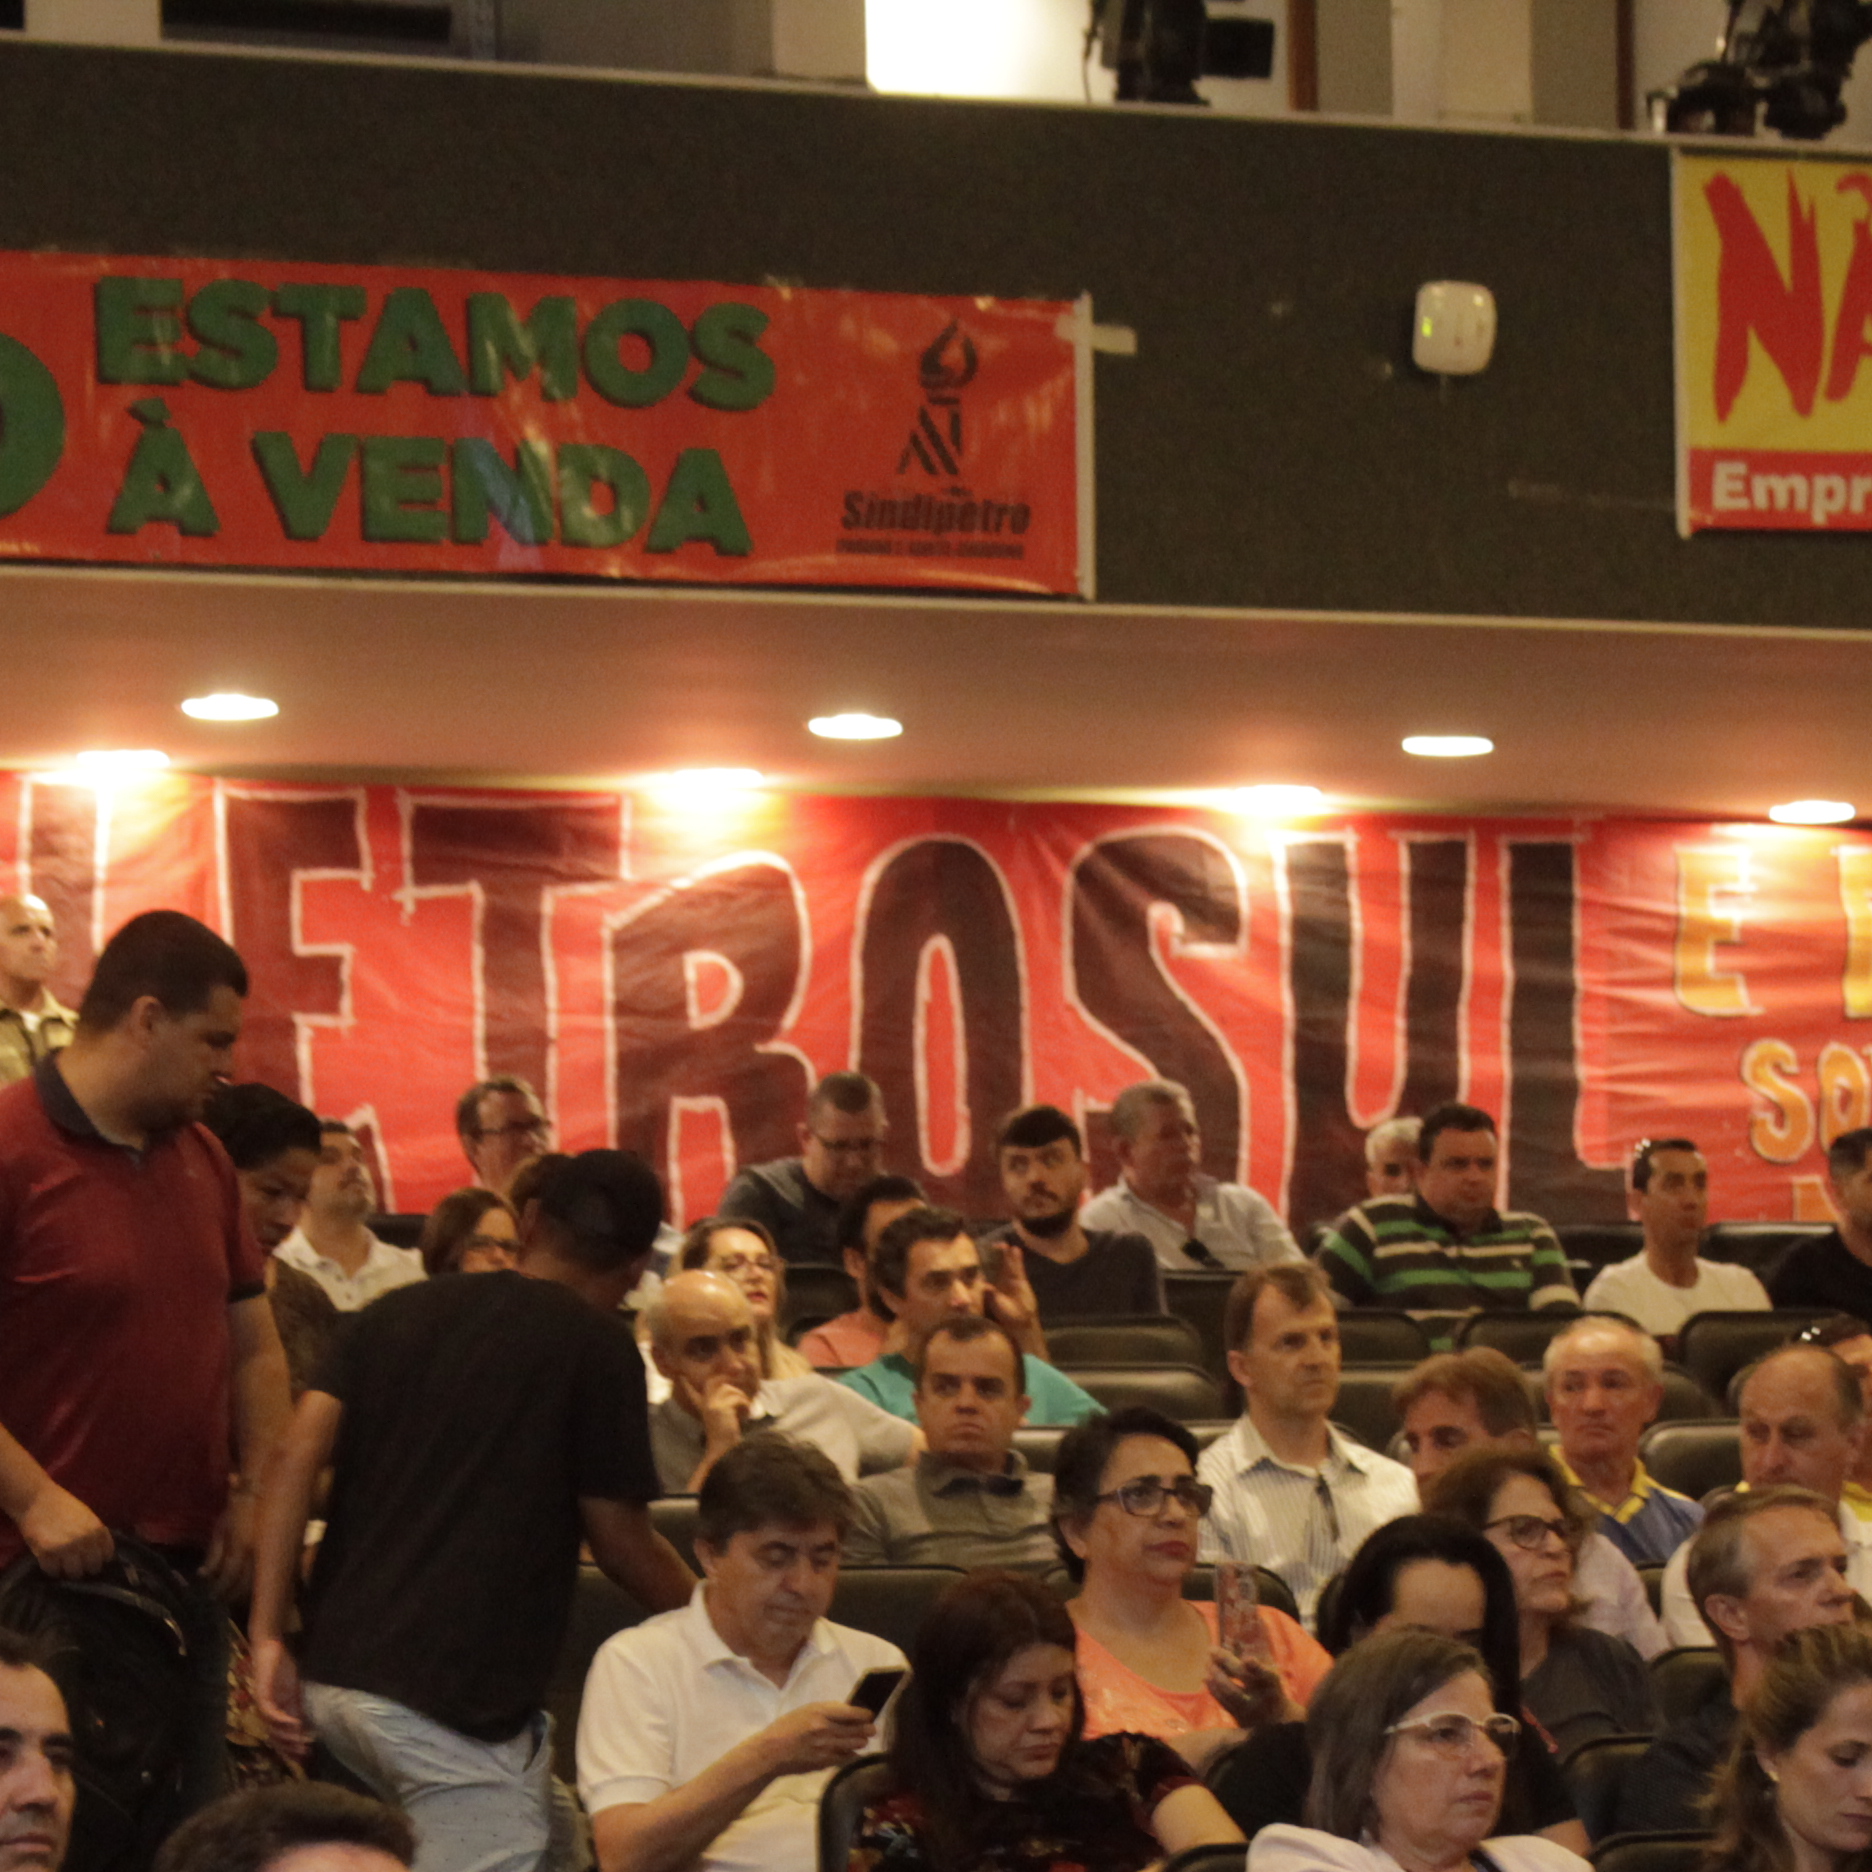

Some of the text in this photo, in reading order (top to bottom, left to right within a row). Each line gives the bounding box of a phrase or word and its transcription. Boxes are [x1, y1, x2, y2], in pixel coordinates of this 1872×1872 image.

[94, 276, 776, 411] ESTAMOS
[107, 396, 752, 556] À VENDA
